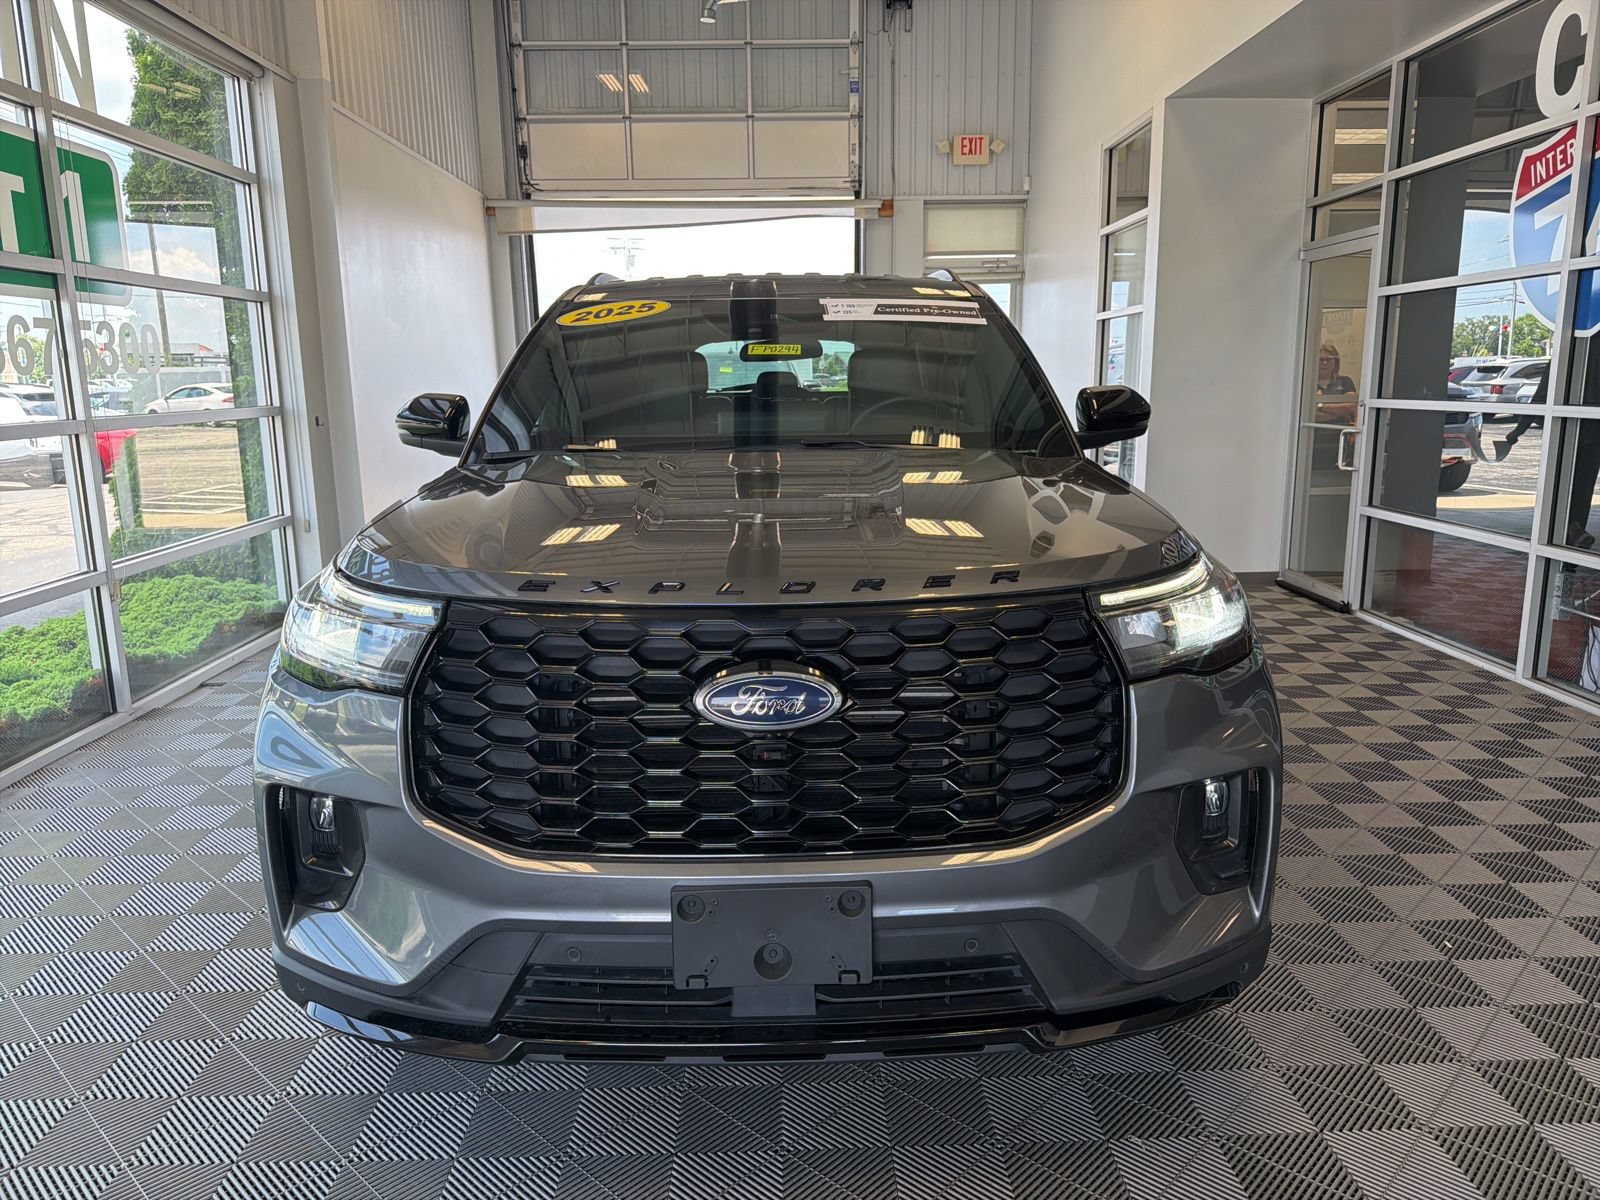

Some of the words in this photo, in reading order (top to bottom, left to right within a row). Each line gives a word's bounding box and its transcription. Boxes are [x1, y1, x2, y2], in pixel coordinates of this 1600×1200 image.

[961, 136, 984, 156] EXIT
[60, 170, 91, 263] 1
[570, 302, 658, 324] 2025
[877, 305, 921, 314] Certified
[923, 307, 978, 317] Pre-Owned
[517, 570, 1020, 595] EXPLORER
[730, 684, 808, 716] Ford
